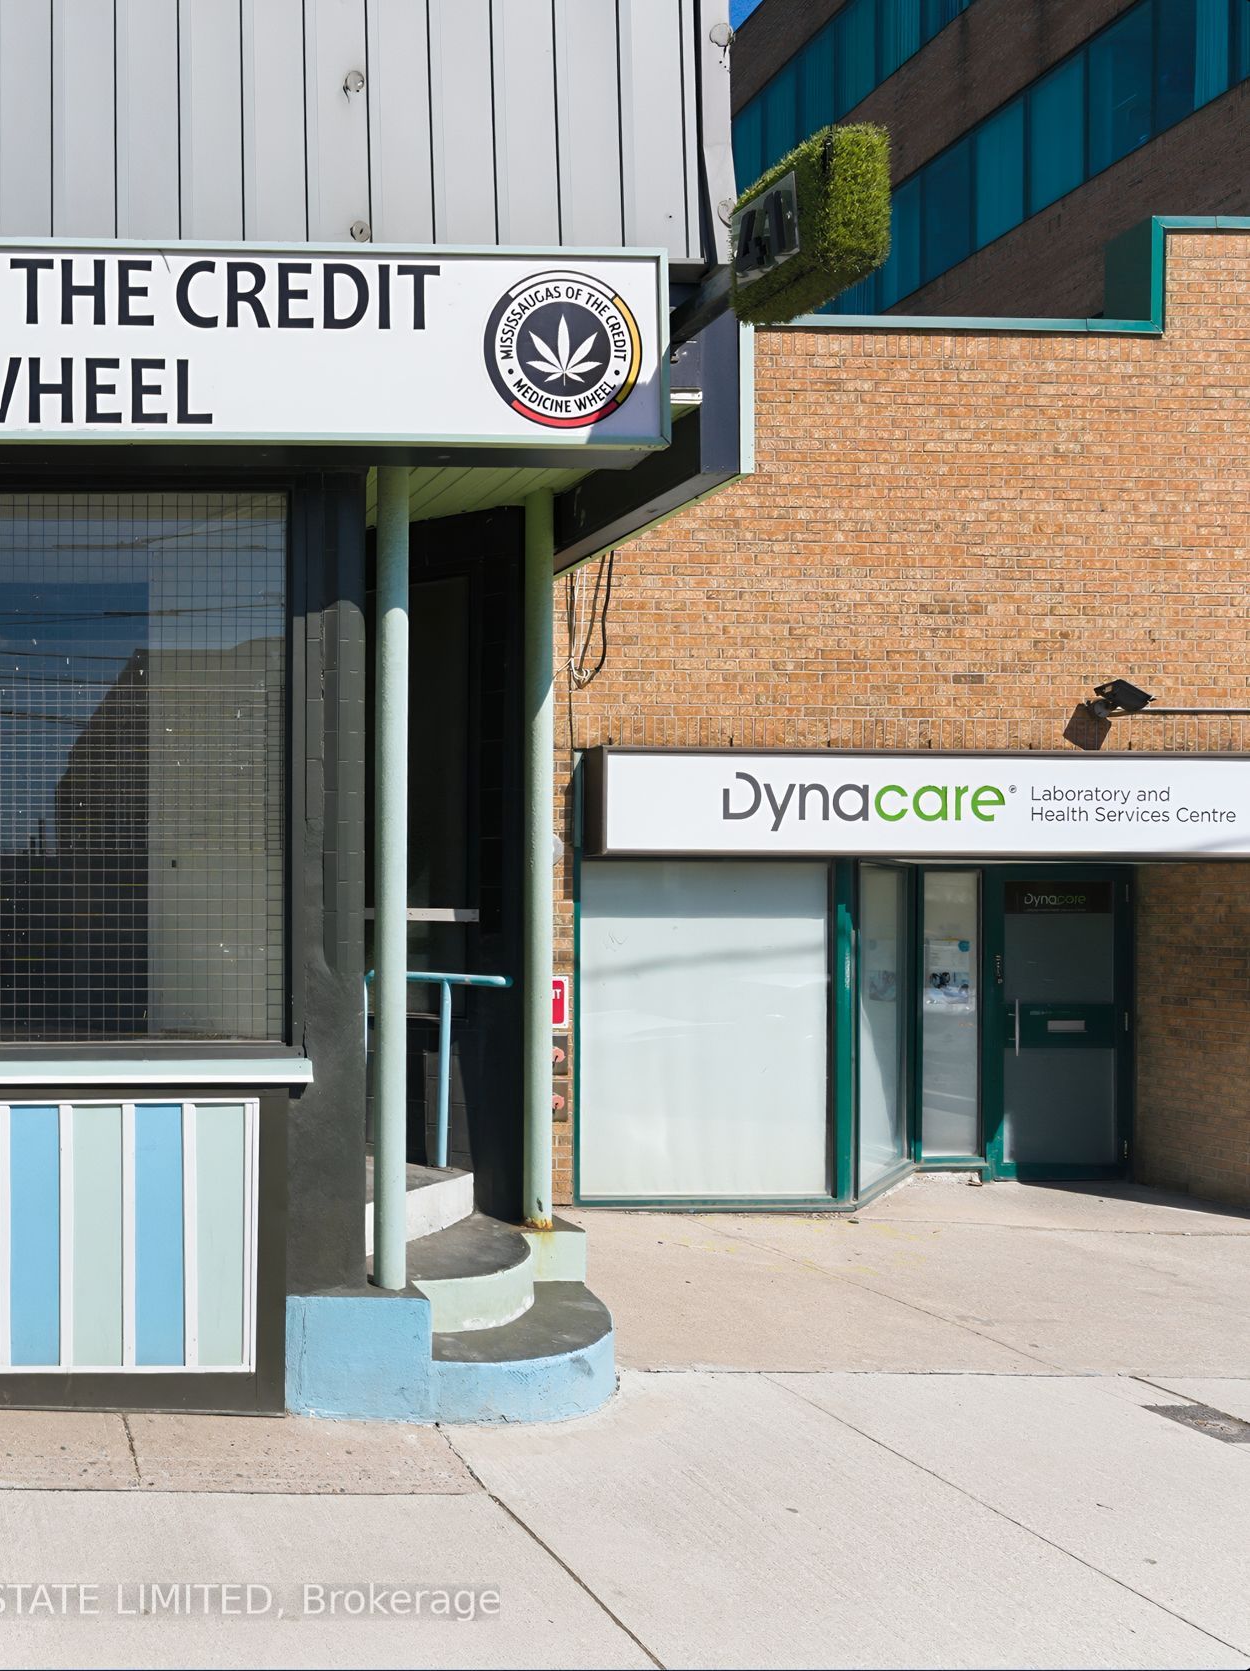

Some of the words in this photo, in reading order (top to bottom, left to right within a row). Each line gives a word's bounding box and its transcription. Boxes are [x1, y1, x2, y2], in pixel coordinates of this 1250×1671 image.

[10, 258, 155, 327] THE
[176, 260, 441, 330] CREDIT
[500, 286, 561, 360] MISSISSAUGAS
[565, 286, 583, 302] OF
[585, 292, 610, 317] THE
[605, 315, 627, 362] CREDIT
[512, 378, 572, 413] MEDICINE
[574, 381, 617, 412] WHEEL
[1031, 786, 1131, 805] Laboratory
[1136, 786, 1171, 802] and
[1031, 806, 1089, 822] Health
[1095, 806, 1170, 823] Services
[1176, 807, 1237, 823] Centre
